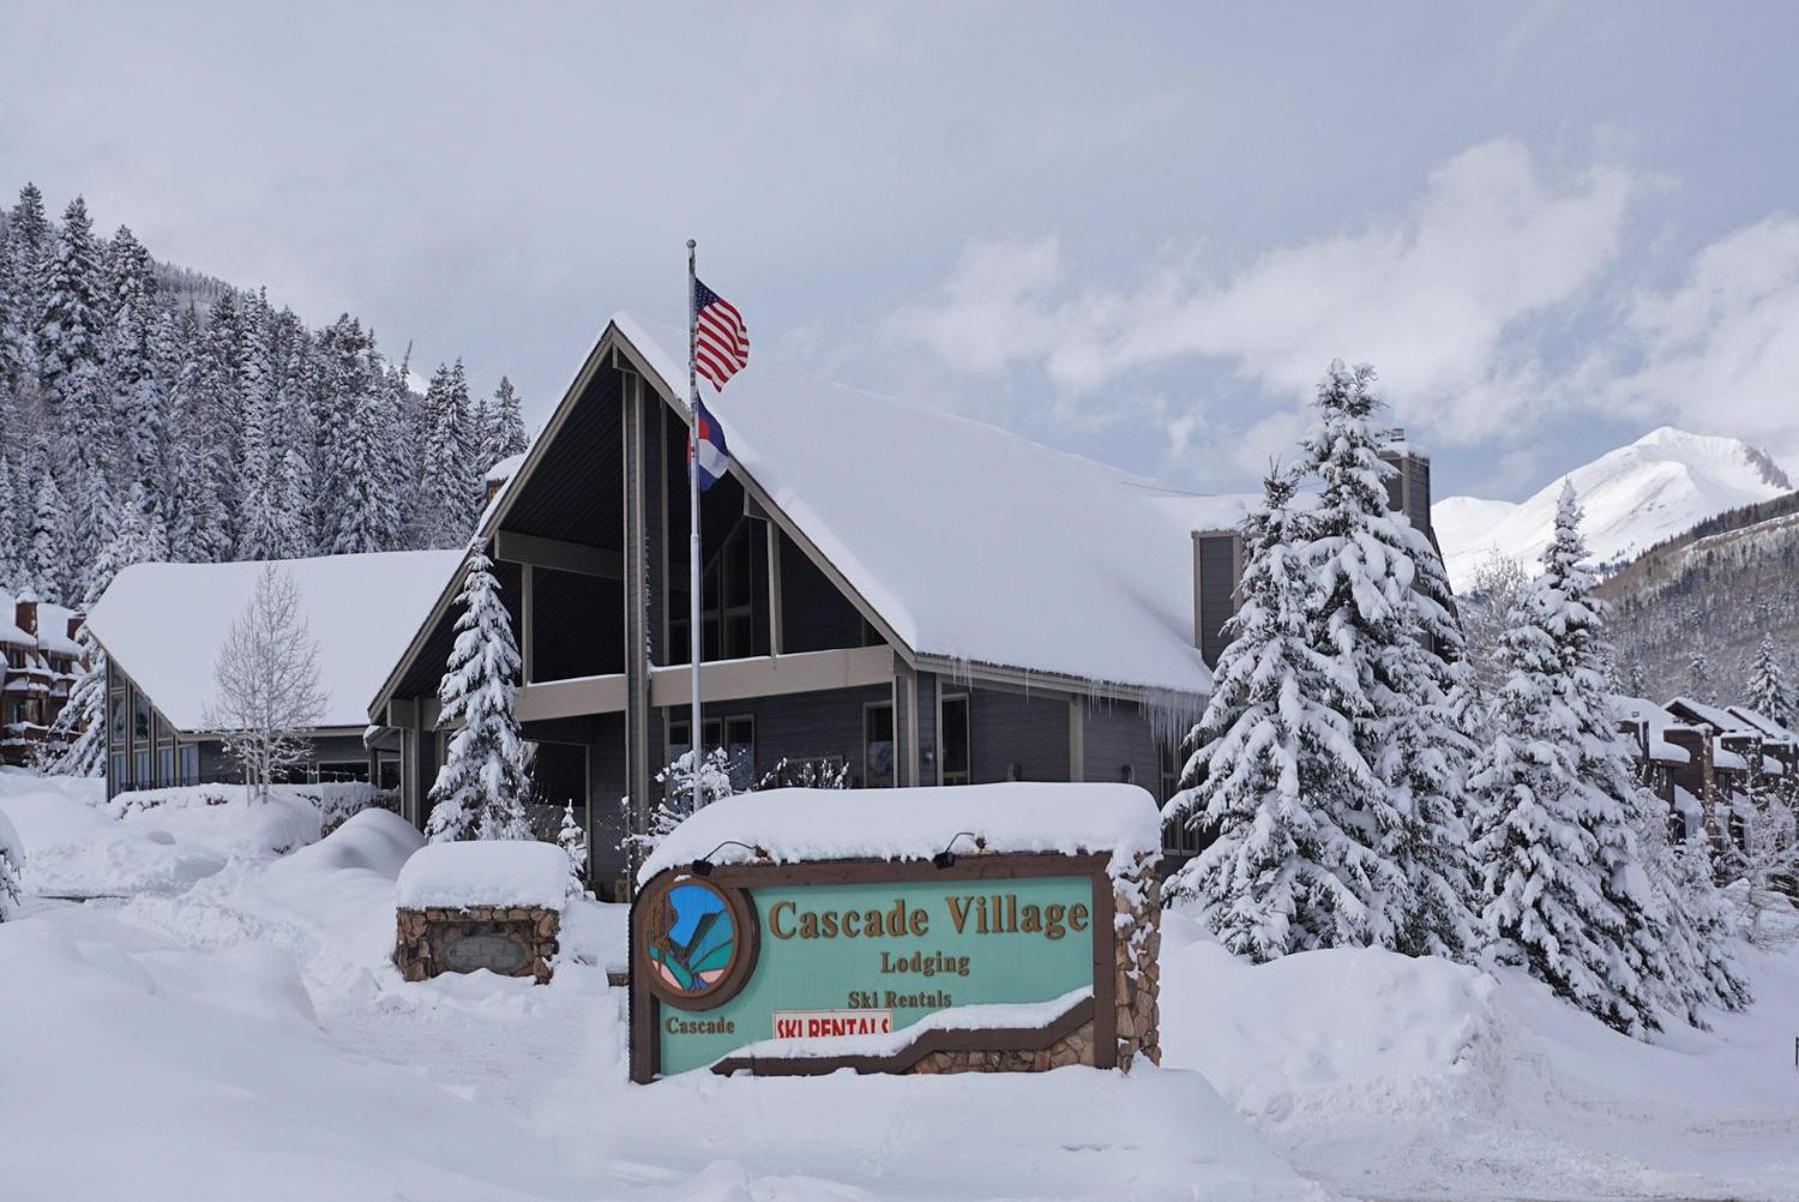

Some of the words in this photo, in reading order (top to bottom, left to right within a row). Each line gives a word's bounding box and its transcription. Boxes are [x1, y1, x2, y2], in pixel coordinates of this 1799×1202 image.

[768, 899, 929, 940] Cascade
[944, 895, 1089, 940] Village
[880, 950, 970, 977] Lodging
[848, 991, 878, 1009] Ski
[884, 990, 952, 1008] Rentals
[665, 1016, 736, 1034] Cascade
[777, 1018, 802, 1039] SKI
